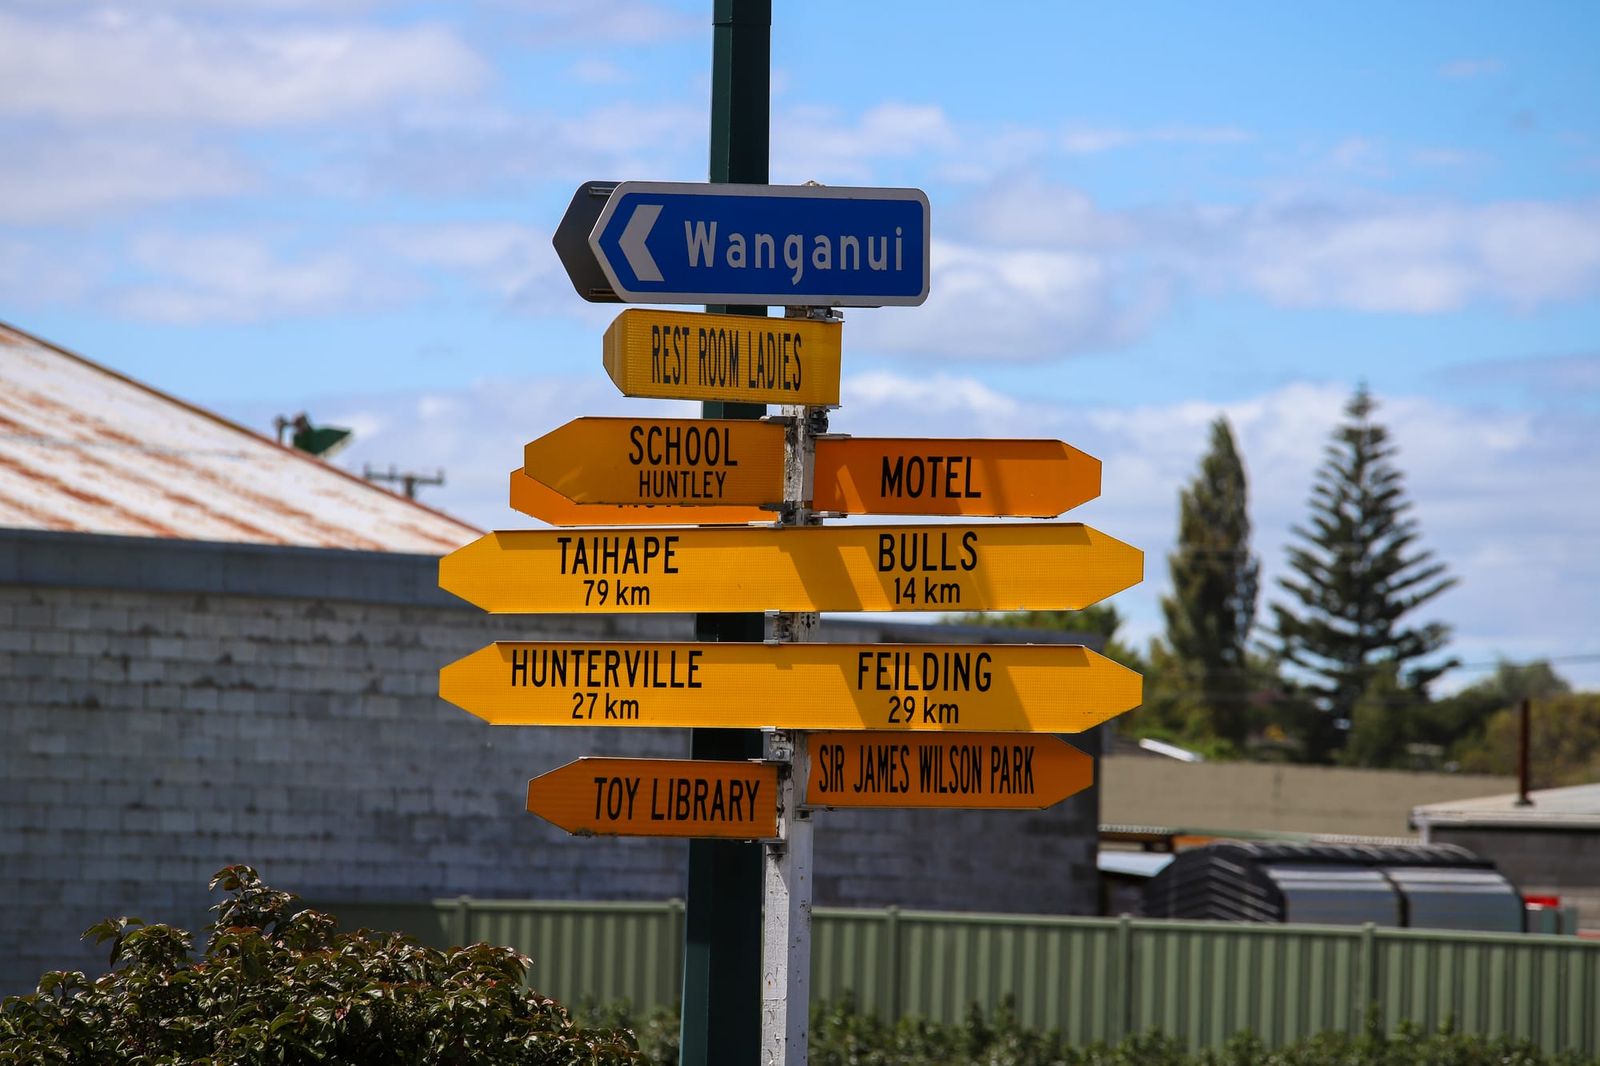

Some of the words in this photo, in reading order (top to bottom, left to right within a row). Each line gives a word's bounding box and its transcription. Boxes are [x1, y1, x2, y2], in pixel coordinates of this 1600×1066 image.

[685, 221, 904, 285] Wanganui
[651, 326, 689, 384] REST
[699, 328, 738, 387] ROOM
[749, 332, 801, 391] LADIES
[629, 426, 737, 466] SCHOOL
[640, 471, 726, 498] HUNTLEY
[881, 456, 981, 498] MOTEL
[557, 536, 679, 574] TAIHAPE
[879, 531, 977, 572] BULLS
[584, 580, 608, 605] 79
[617, 580, 649, 605] km
[895, 578, 915, 604] 14
[925, 577, 960, 603] km
[512, 649, 702, 688] HUNTERVILLE
[858, 652, 991, 692] FEILDING
[573, 693, 597, 719] 27
[606, 693, 638, 719] km
[888, 696, 915, 723] 29
[924, 697, 958, 723] km
[819, 745, 844, 792] SIR
[854, 745, 909, 793] JAMES
[919, 745, 982, 793] WILSON
[991, 746, 1034, 793] PARK
[595, 777, 640, 820] TOY
[652, 779, 760, 821] LIBRARY
